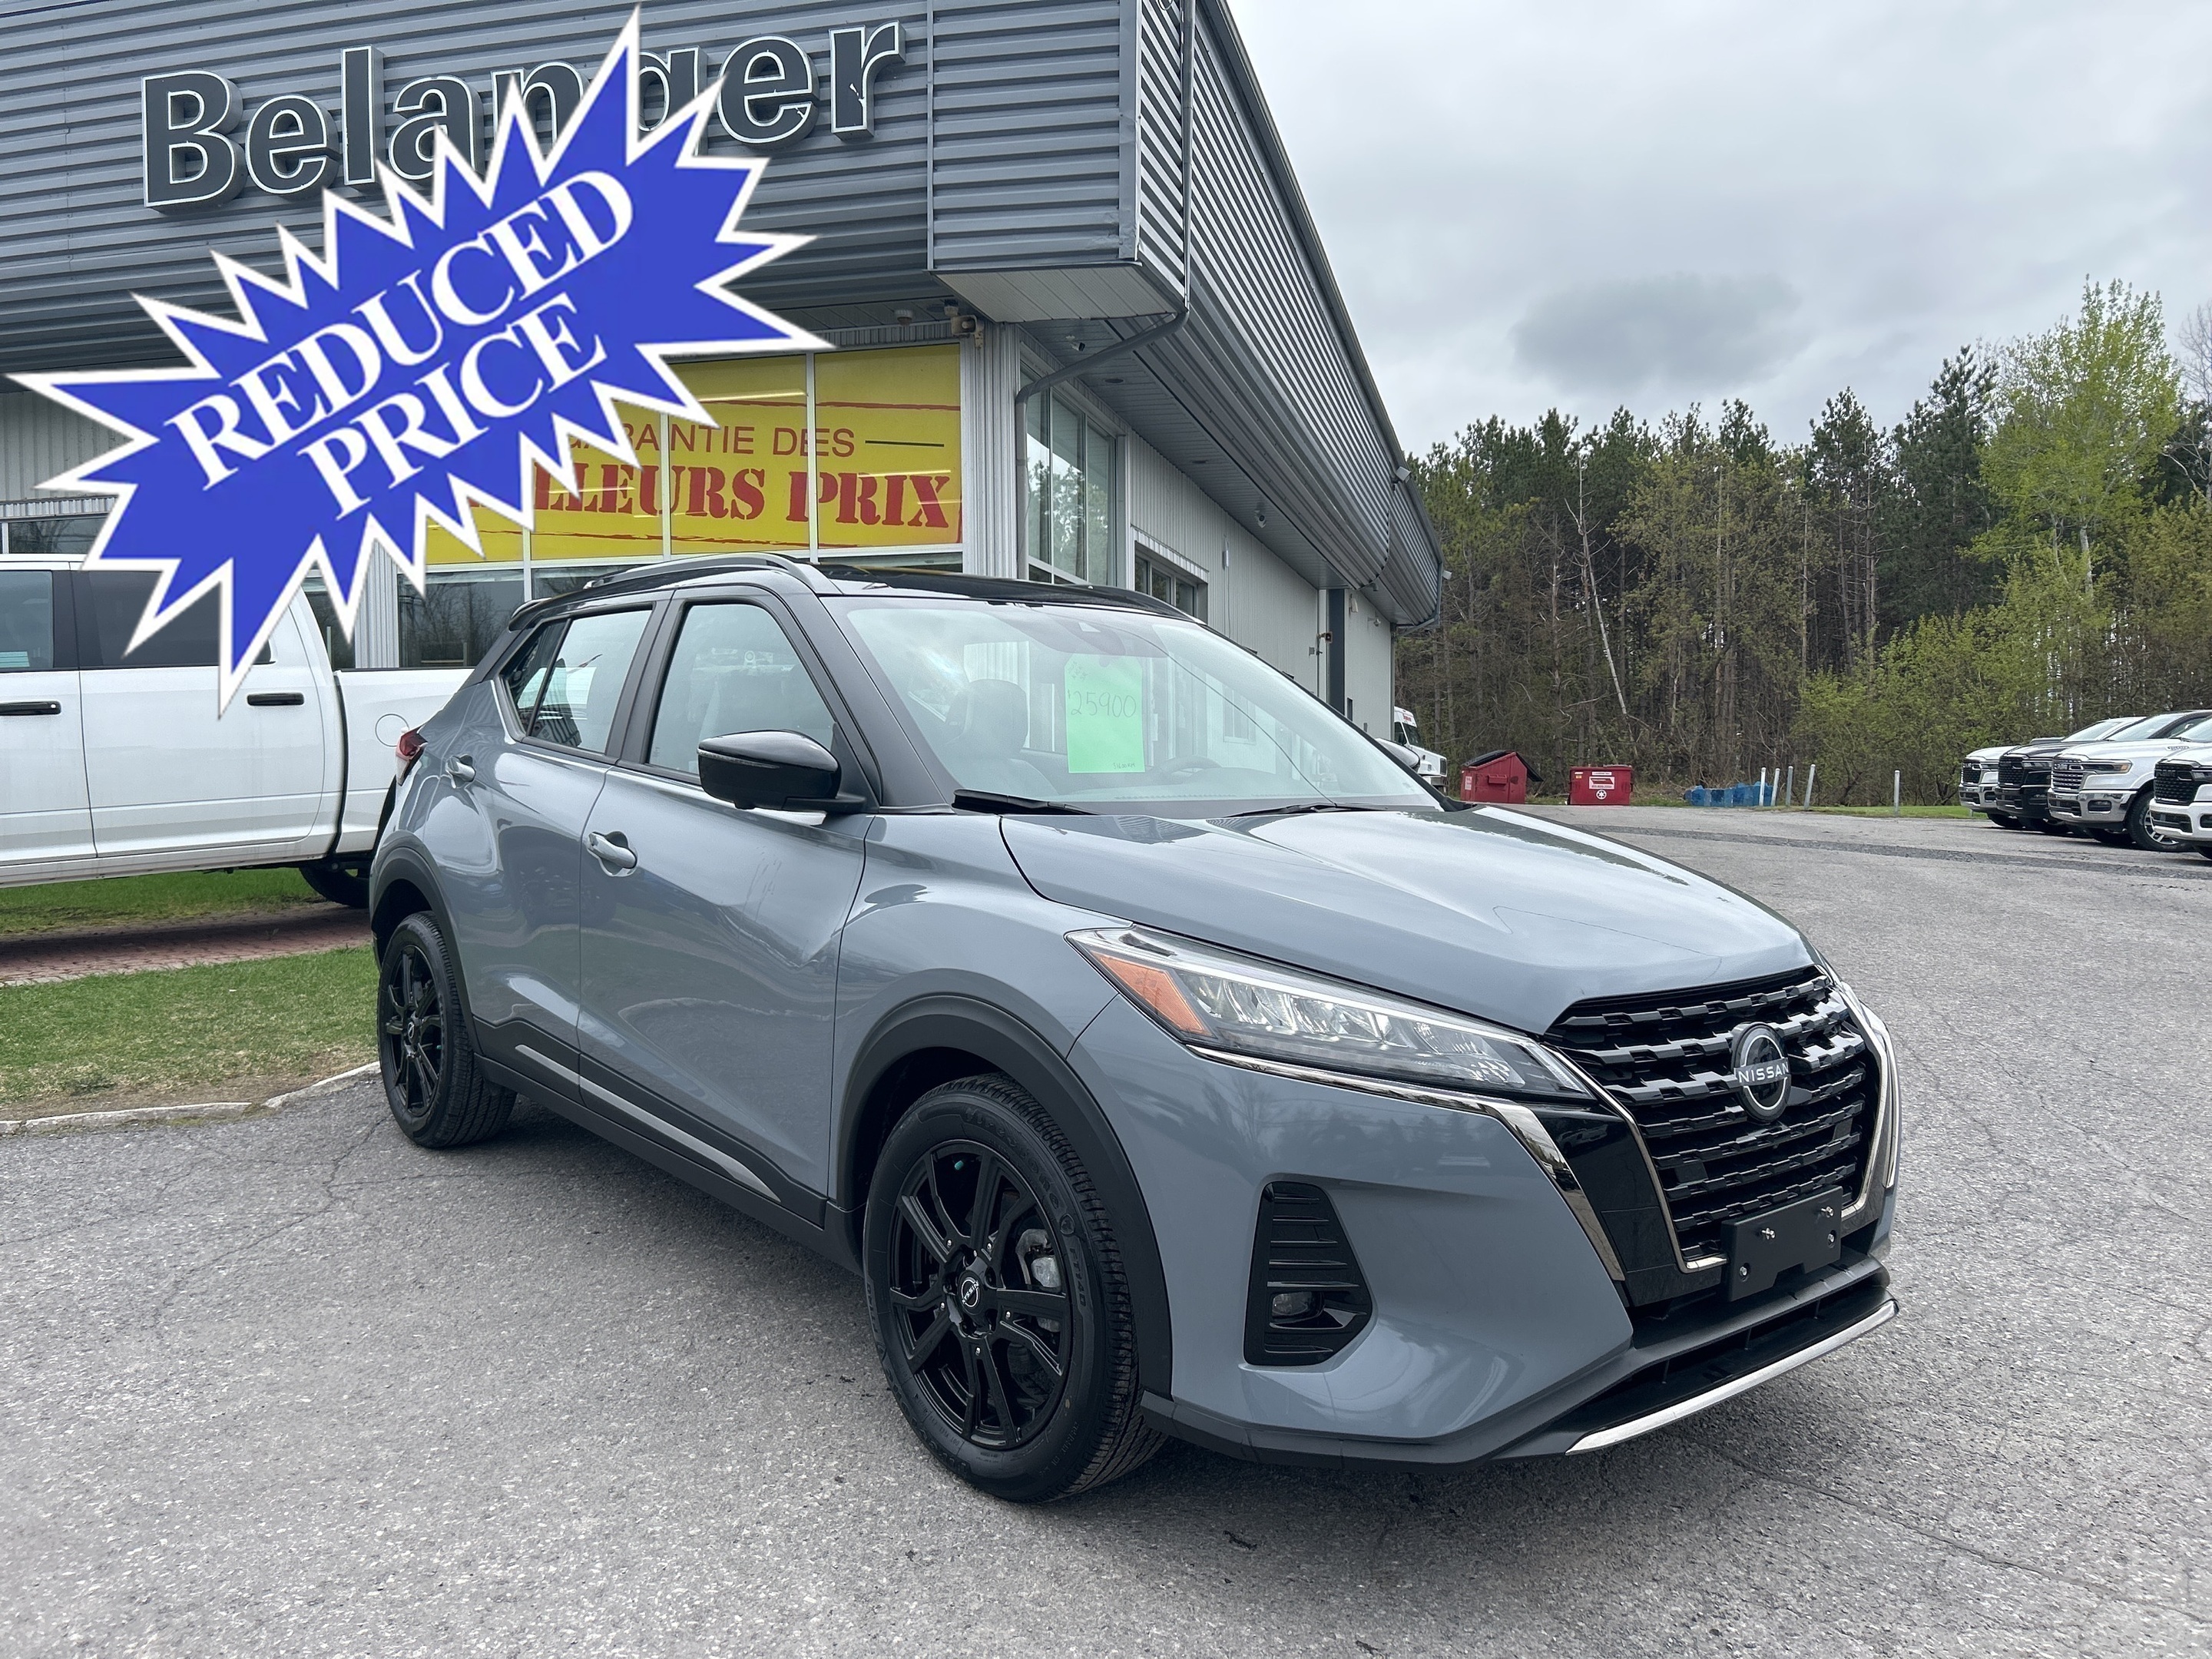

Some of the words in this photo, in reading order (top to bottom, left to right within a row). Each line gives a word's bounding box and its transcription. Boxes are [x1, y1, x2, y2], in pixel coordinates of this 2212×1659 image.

[773, 427, 855, 457] DES
[786, 471, 950, 528] PRIX
[1738, 1061, 1790, 1083] NISSAN
